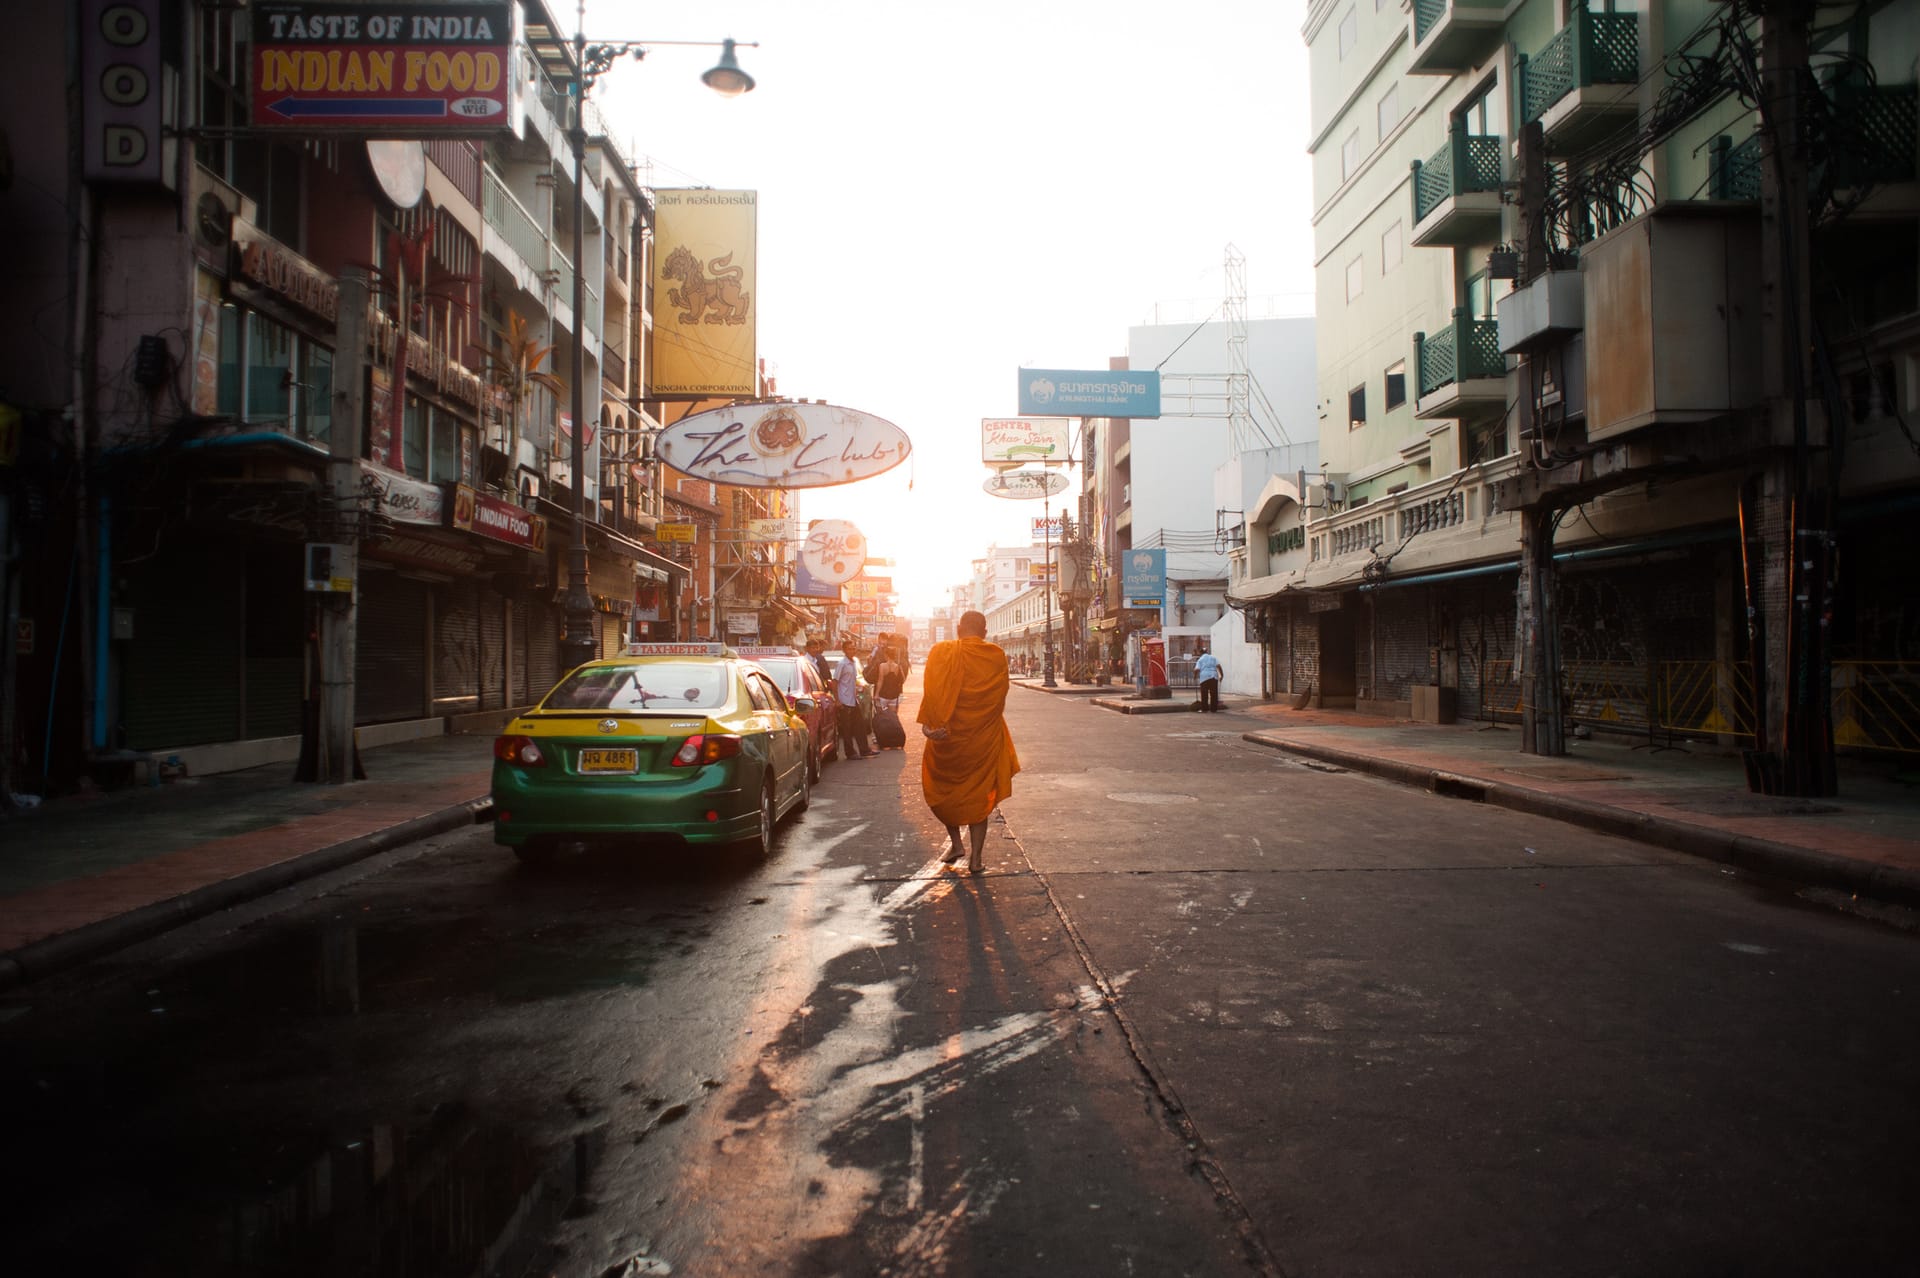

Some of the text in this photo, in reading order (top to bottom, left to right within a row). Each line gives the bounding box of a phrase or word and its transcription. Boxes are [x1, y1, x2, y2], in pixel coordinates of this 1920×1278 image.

[269, 14, 494, 41] TASTE OF INDIA
[260, 49, 501, 93] INDIAN FOOD
[655, 384, 751, 392] SINGHA CORPORATION
[1059, 381, 1146, 397] ธนาคารกรุงไทย
[985, 421, 1032, 432] CENTER
[985, 432, 1024, 445] Khao
[684, 422, 896, 472] The Club
[480, 506, 509, 531] INDIAN
[509, 517, 529, 537] FOOD
[641, 645, 708, 655] TAXI-METER
[738, 647, 777, 655] TAXI-METER
[604, 750, 634, 764] 4861
